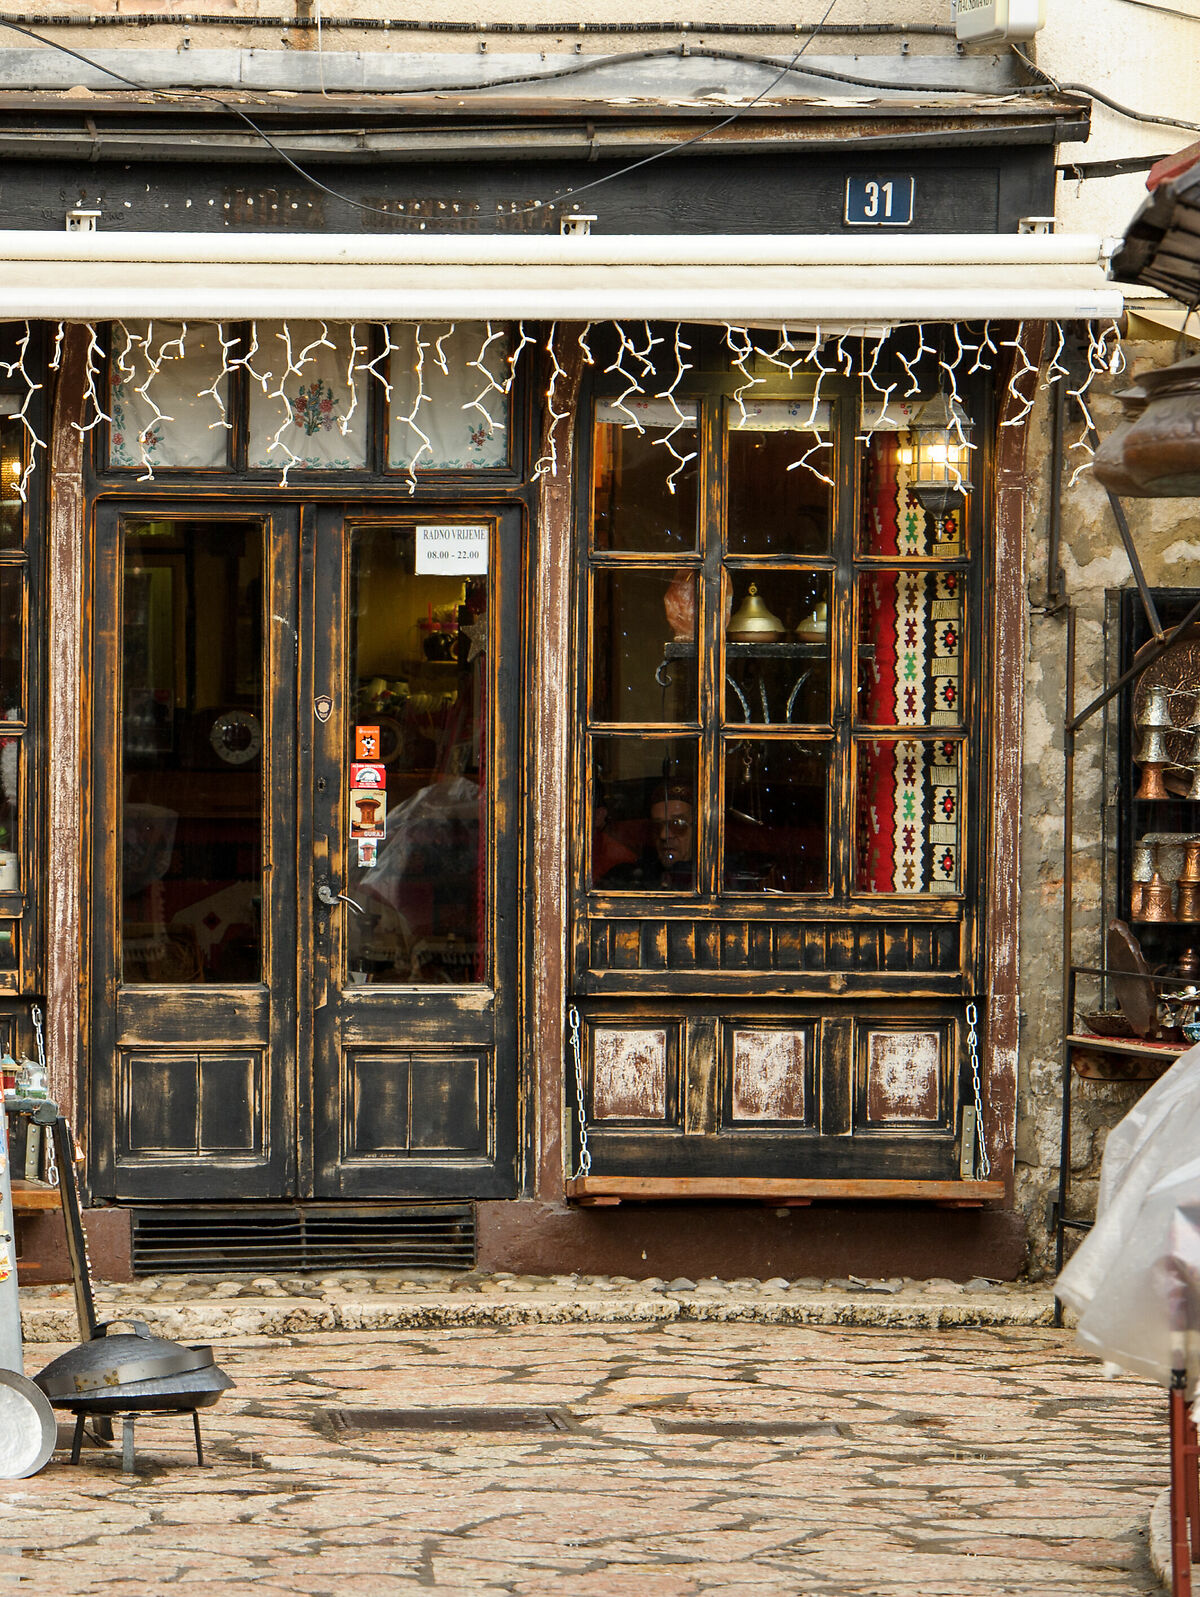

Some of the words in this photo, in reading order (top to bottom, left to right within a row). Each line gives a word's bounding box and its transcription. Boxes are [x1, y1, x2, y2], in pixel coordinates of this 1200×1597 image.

[864, 181, 893, 217] 31
[423, 529, 450, 540] RADNO
[451, 529, 486, 540] VRIJEME
[427, 550, 449, 560] 08.00
[457, 550, 480, 560] 22.00
